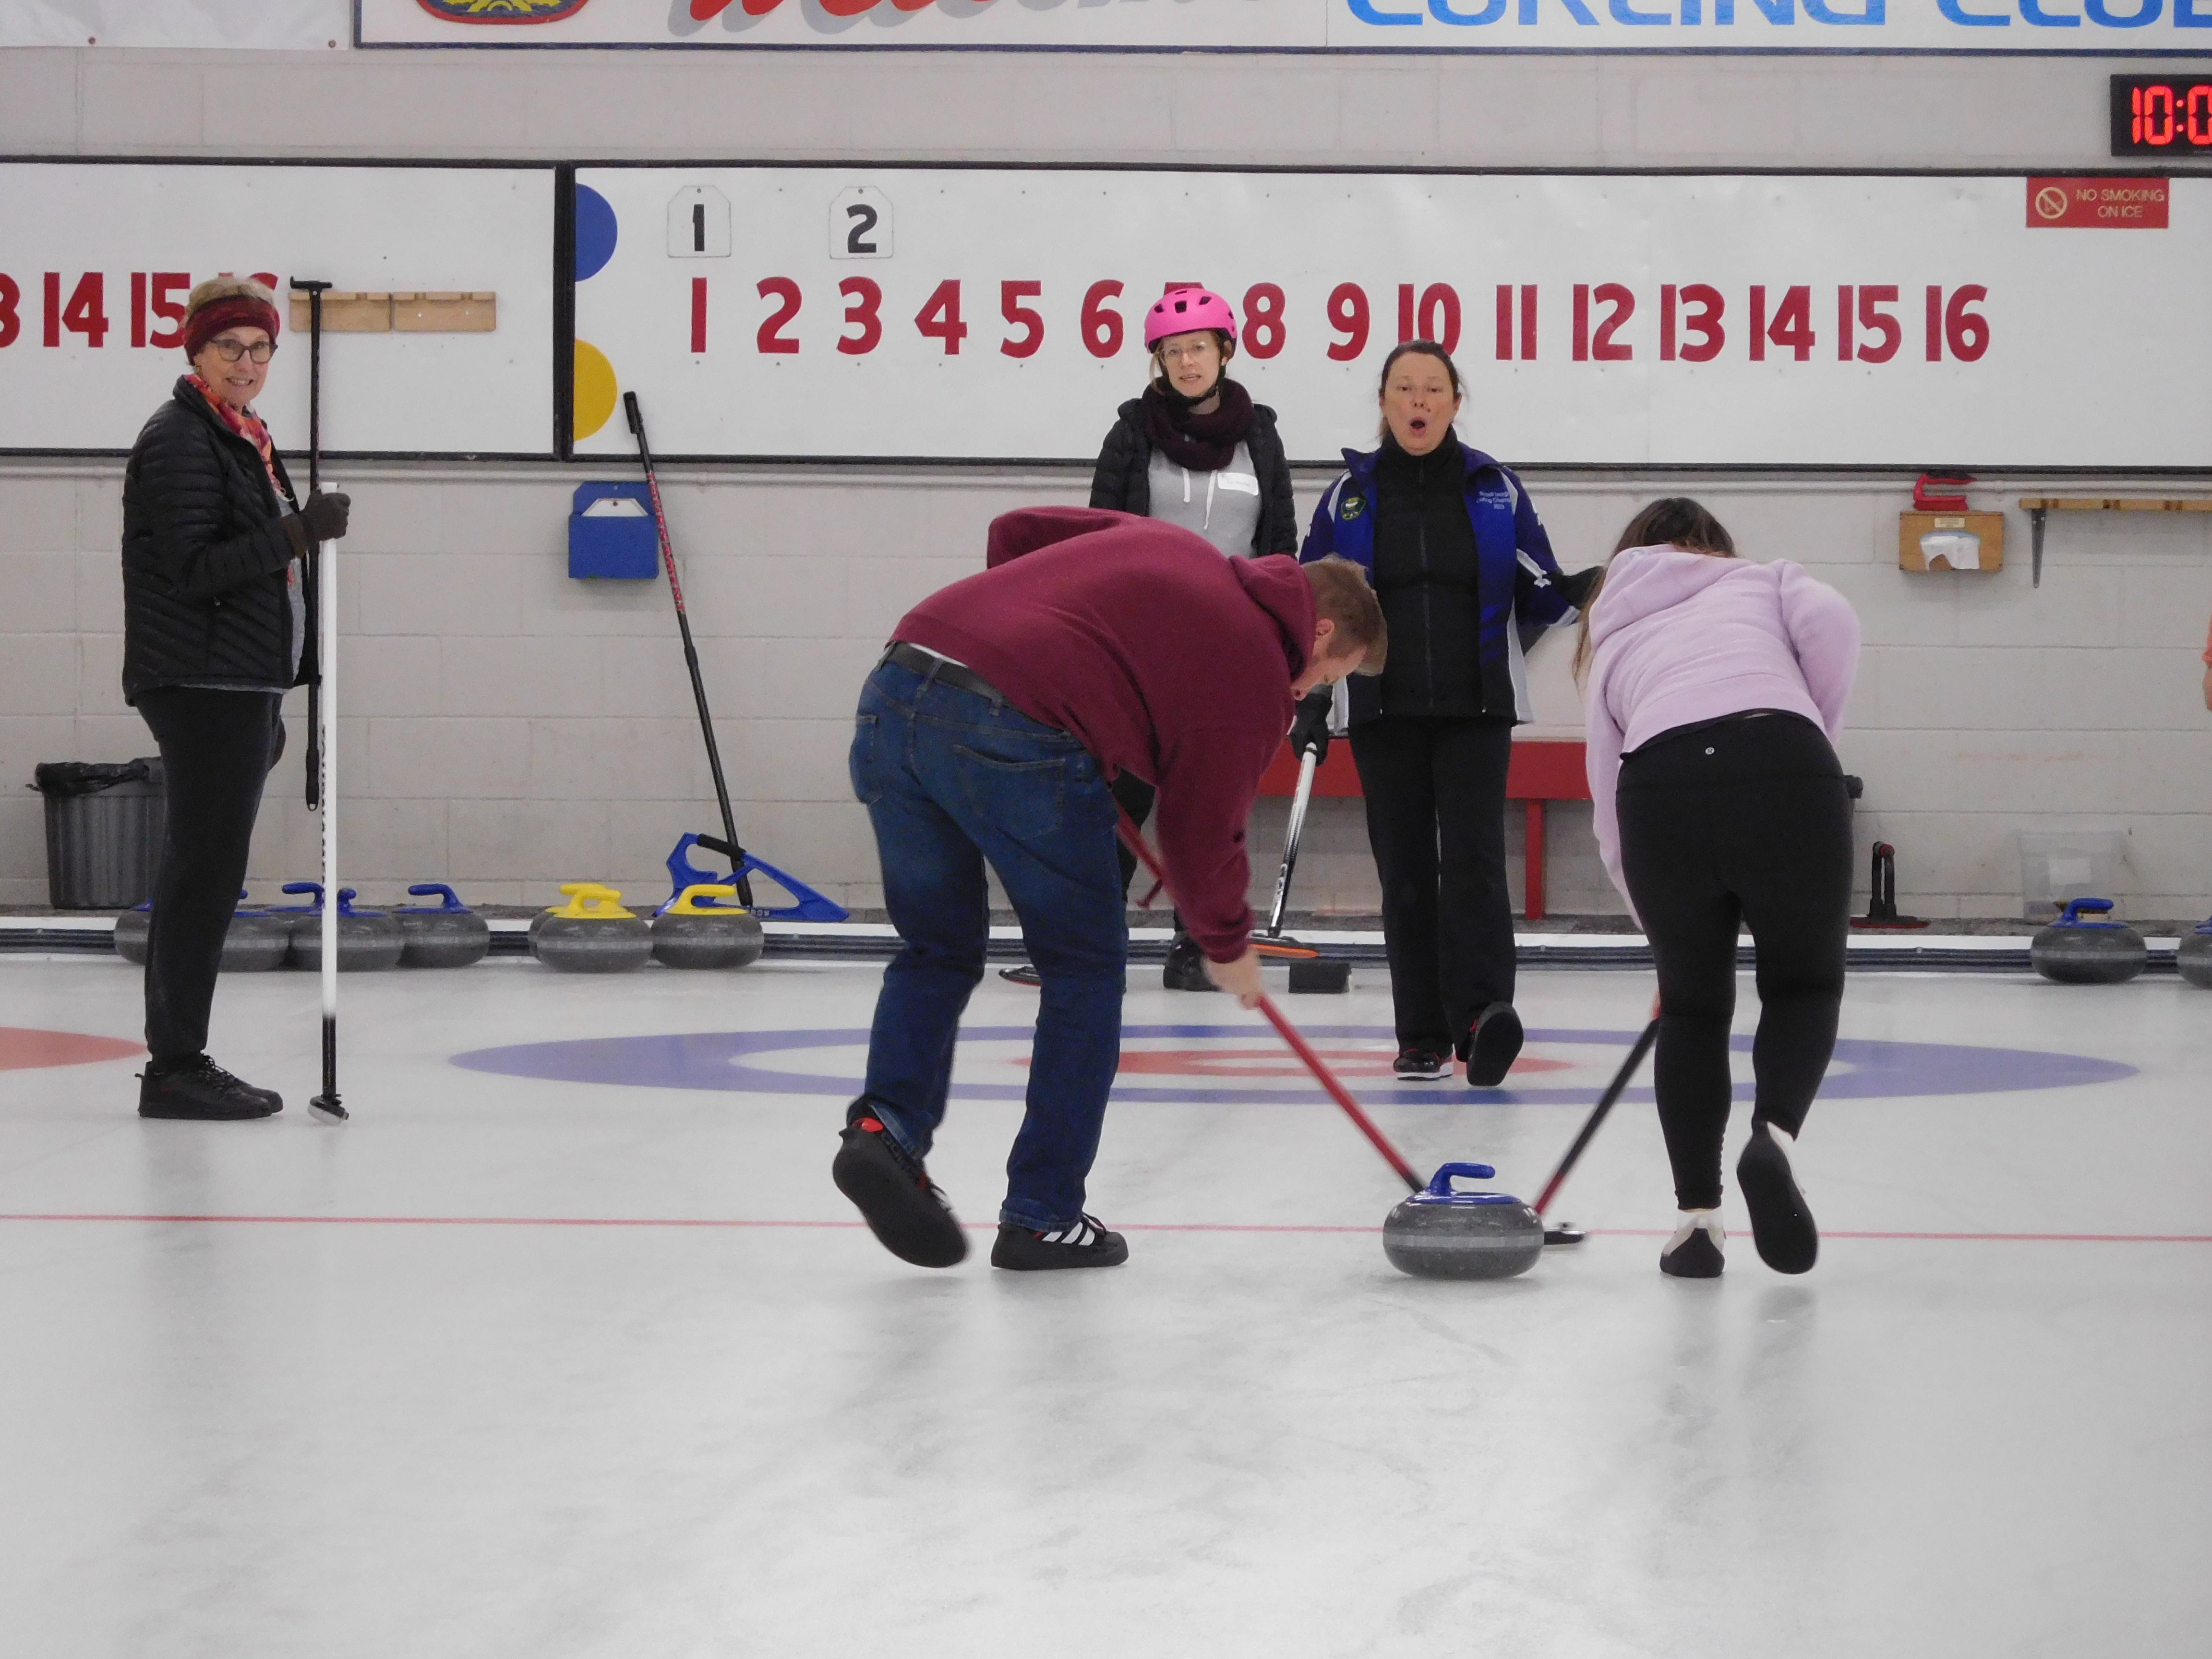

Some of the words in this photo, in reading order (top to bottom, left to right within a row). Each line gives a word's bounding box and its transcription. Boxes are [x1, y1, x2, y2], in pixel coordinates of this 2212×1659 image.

[2076, 189, 2097, 201] NO
[2101, 189, 2165, 202] SMOKING
[2097, 205, 2118, 217] ON
[2121, 206, 2143, 218] ICE
[692, 204, 705, 252] 1
[846, 204, 877, 253] 2
[44, 272, 109, 348] 14
[131, 272, 196, 349] 15
[691, 277, 708, 353] 1
[757, 277, 802, 354] 2
[838, 276, 882, 356] 3
[915, 279, 968, 355] 4
[1001, 280, 1045, 359] 5
[1081, 280, 1124, 359] 6
[1242, 283, 1286, 360] 8
[1327, 283, 1370, 361] 9
[1398, 282, 1462, 356] 10
[1496, 285, 1538, 361] 11
[1573, 283, 1635, 361] 12
[1660, 284, 1725, 362] 13
[1750, 285, 1815, 361] 14
[1839, 285, 1901, 363] 15
[1926, 284, 1990, 362] 16
